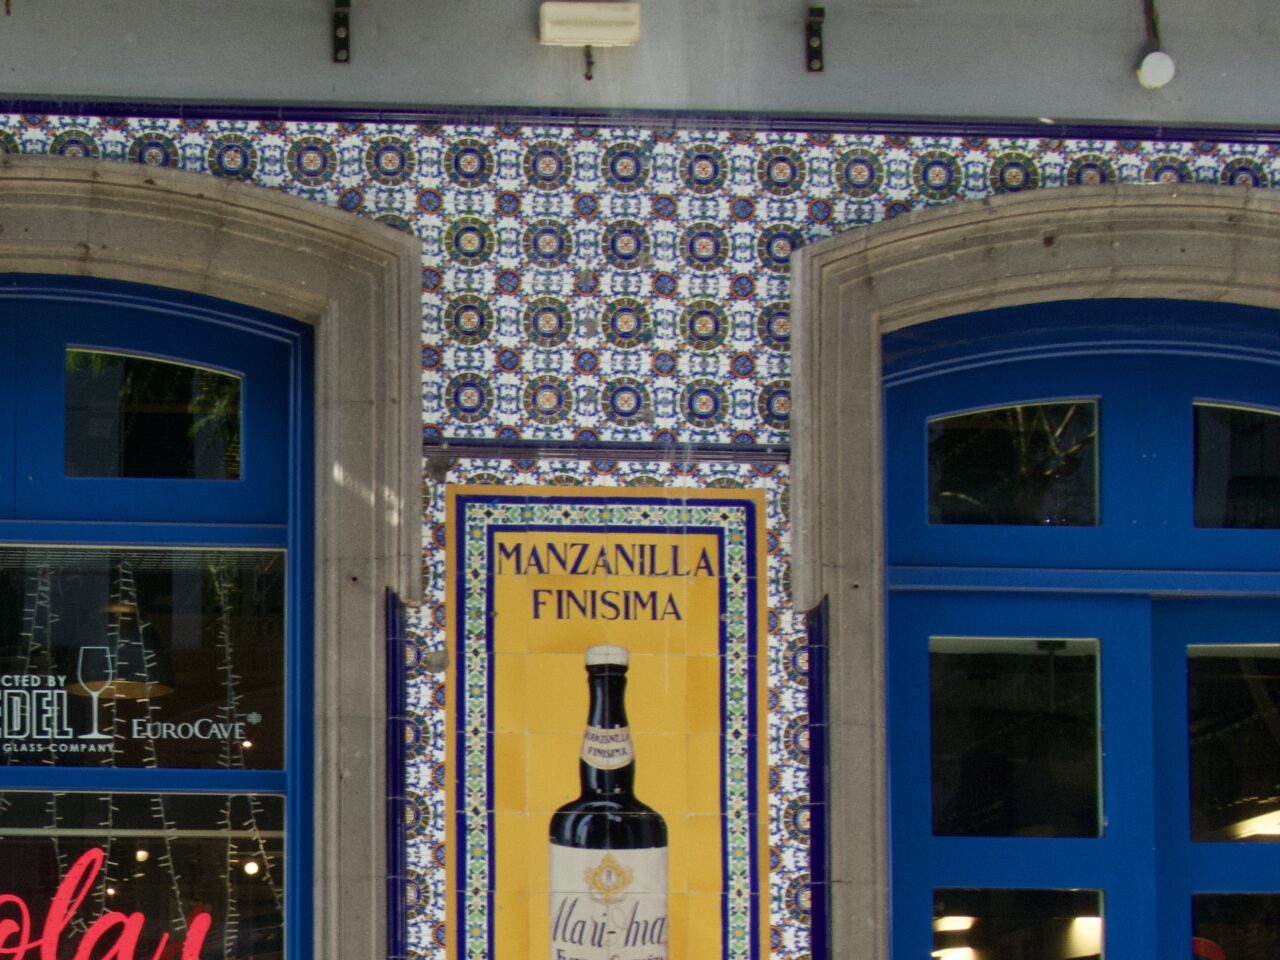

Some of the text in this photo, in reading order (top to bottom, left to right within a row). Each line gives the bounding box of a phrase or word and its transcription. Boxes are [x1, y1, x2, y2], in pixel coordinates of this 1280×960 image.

[497, 542, 715, 577] MANZANILLA
[532, 589, 683, 621] FINISIMA
[48, 675, 67, 687] BY
[3, 743, 43, 752] GLASS
[48, 743, 114, 752] COMPANY
